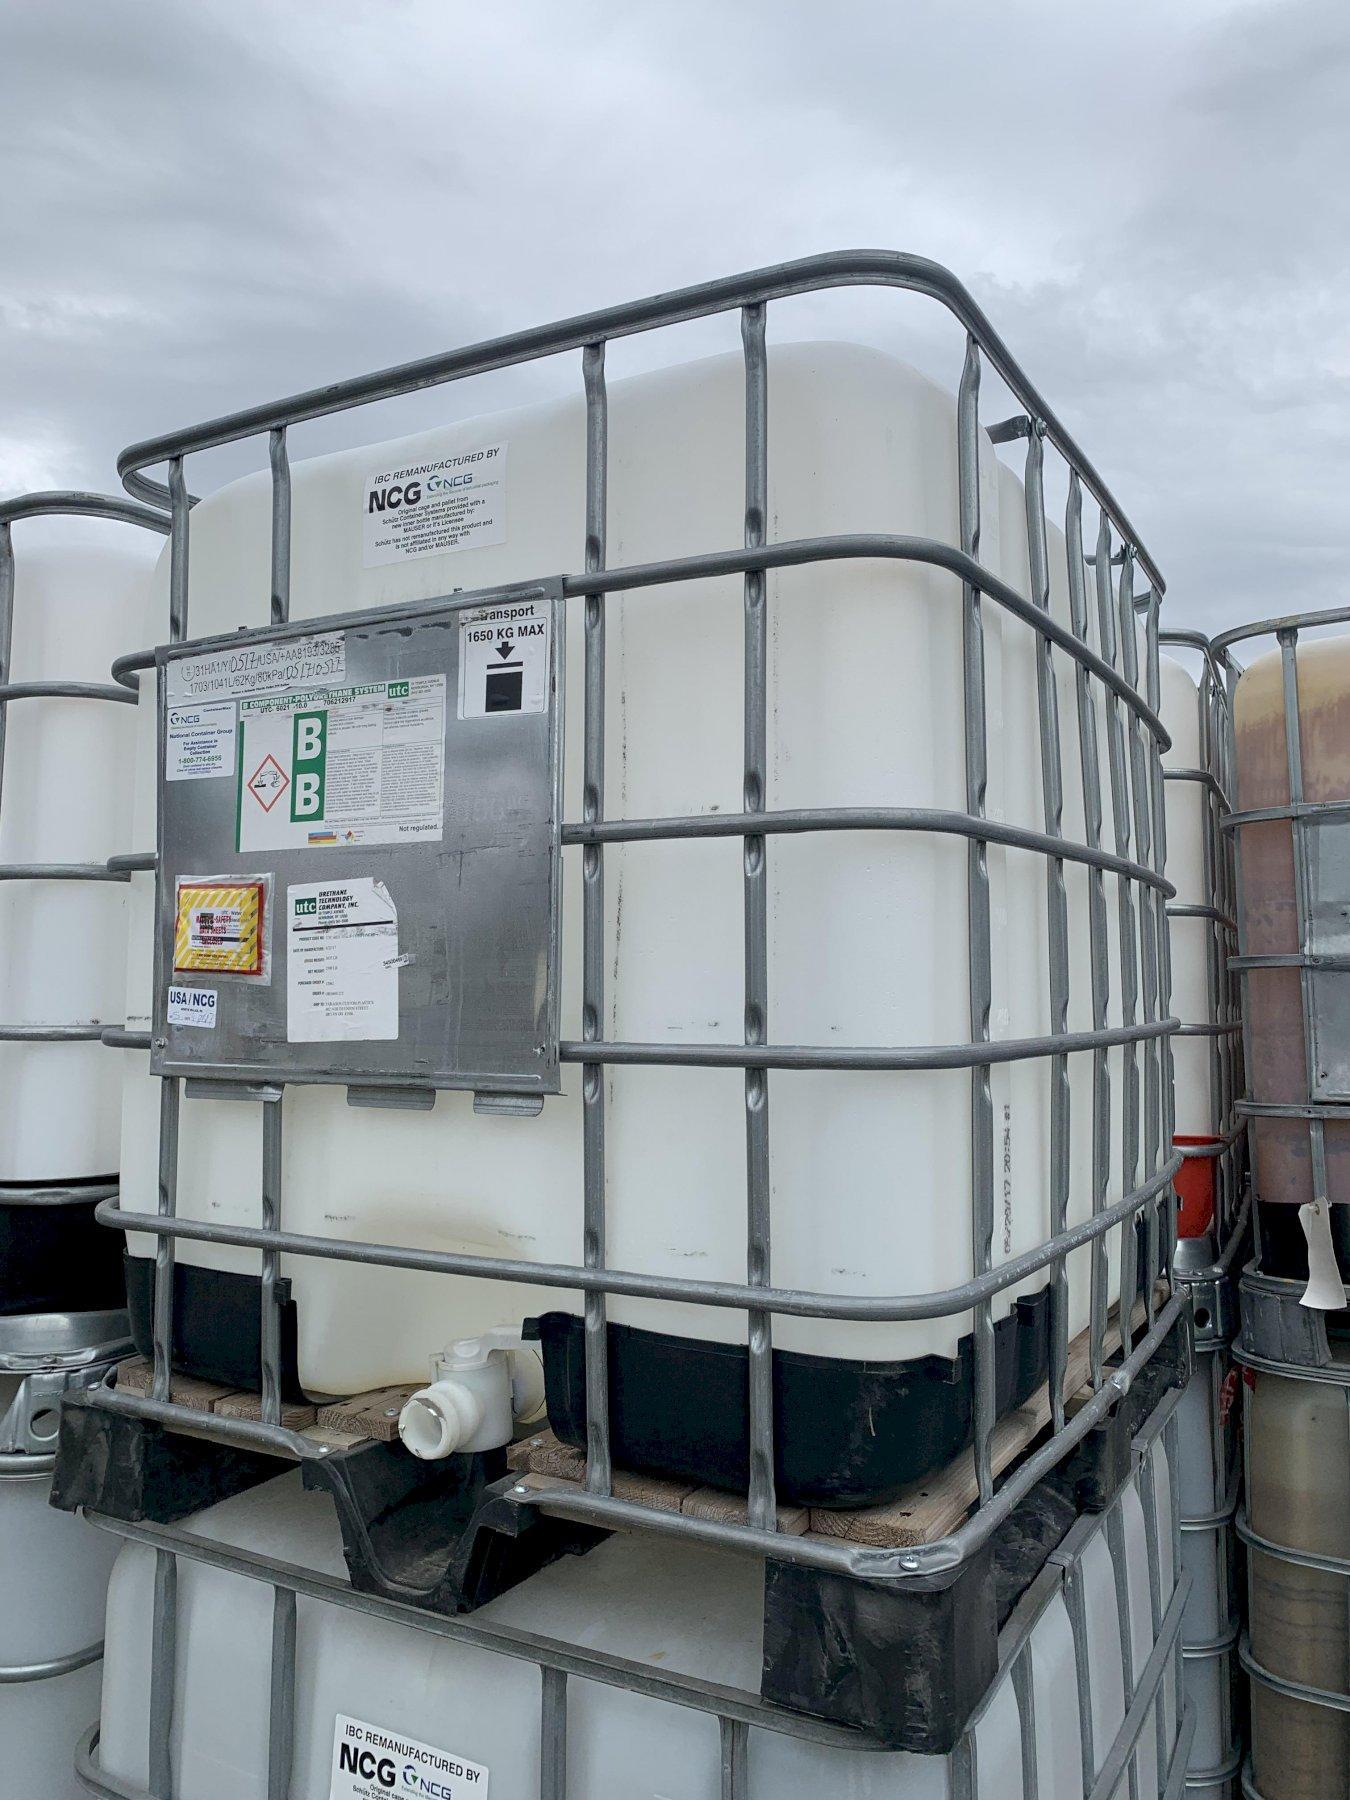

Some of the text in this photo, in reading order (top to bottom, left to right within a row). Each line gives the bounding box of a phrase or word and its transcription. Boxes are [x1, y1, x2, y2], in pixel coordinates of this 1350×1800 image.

[374, 447, 500, 484] IBC REMANUFACTURED BY
[443, 473, 473, 490] NCG
[369, 482, 421, 514] NCG
[397, 506, 417, 516] Original
[441, 497, 456, 508] pallet
[399, 512, 424, 522] Container
[424, 507, 446, 517] Systems
[446, 502, 469, 512] provided
[431, 509, 466, 521] manufactured
[403, 524, 426, 533] MAUSER
[410, 528, 450, 540] remanufactured
[461, 521, 482, 531] product
[482, 518, 492, 526] and
[405, 546, 417, 554] NCG
[484, 604, 534, 620] ransport
[467, 623, 544, 642] 1650 KG MAX
[242, 702, 249, 710] B
[354, 684, 385, 695] SYSTEM
[389, 684, 408, 697] utc
[323, 697, 356, 706] 706212917
[180, 714, 200, 724] NCG
[190, 730, 216, 738] Container
[296, 717, 322, 760] B
[295, 773, 320, 816] B
[410, 824, 438, 832] regulated.
[318, 889, 348, 898] URETHANE
[318, 895, 353, 904] TECHNOLOGY
[296, 900, 316, 913] utc
[345, 1724, 480, 1783] IBC REMANUFACTURED BY
[339, 1742, 396, 1788] NCG
[369, 1784, 390, 1796] Original
[419, 1778, 452, 1800] NCG
